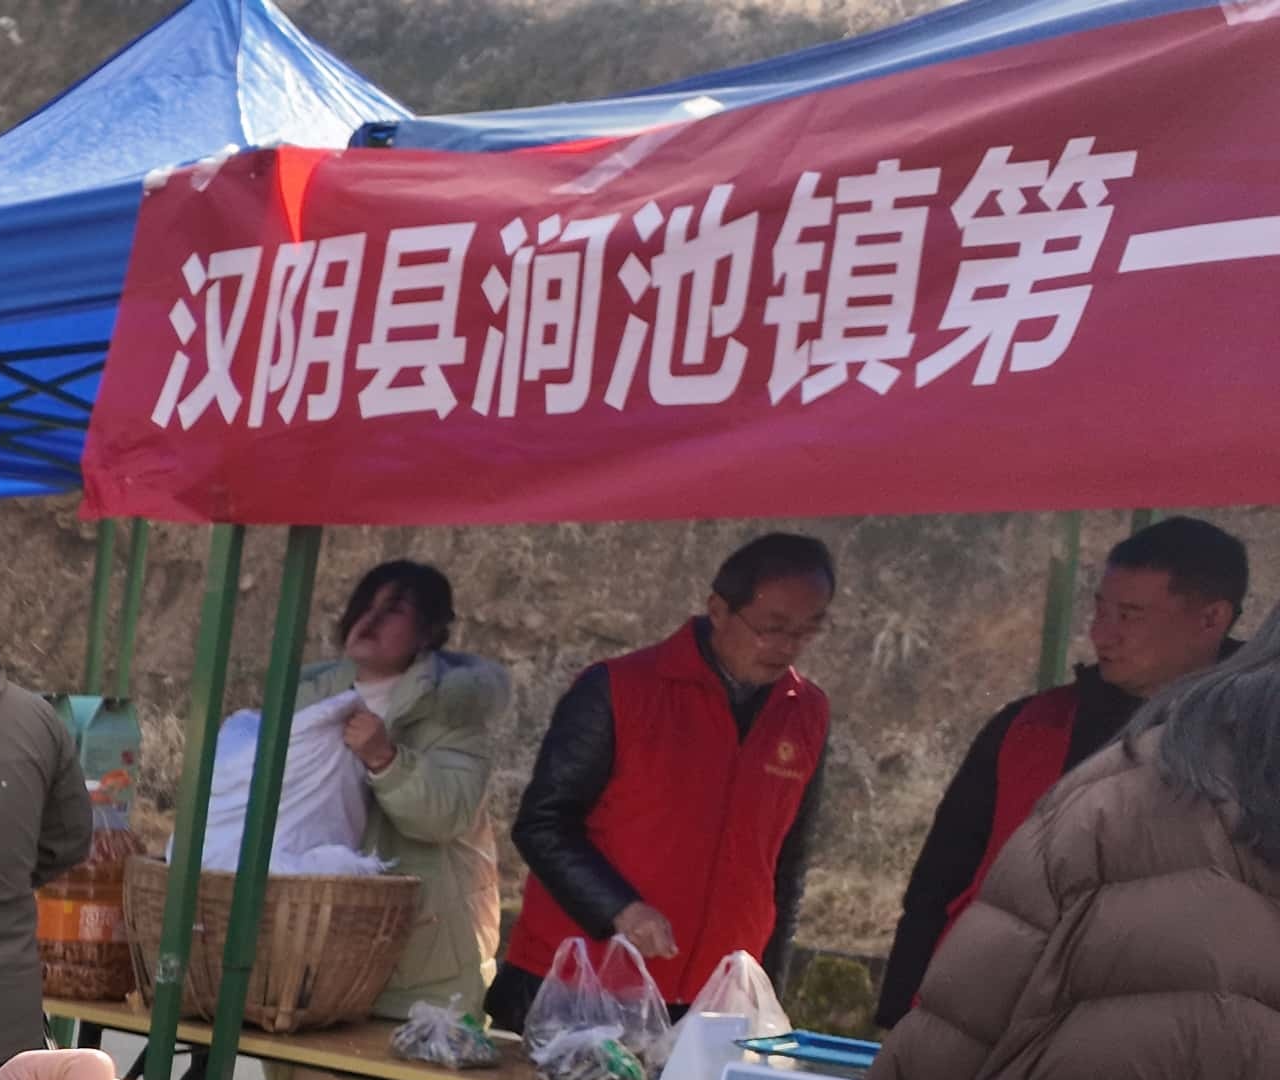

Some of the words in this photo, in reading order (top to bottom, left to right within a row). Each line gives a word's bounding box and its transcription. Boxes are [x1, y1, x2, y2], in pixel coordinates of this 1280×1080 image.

[151, 133, 1280, 430] 汉阴县涧池镇第一
